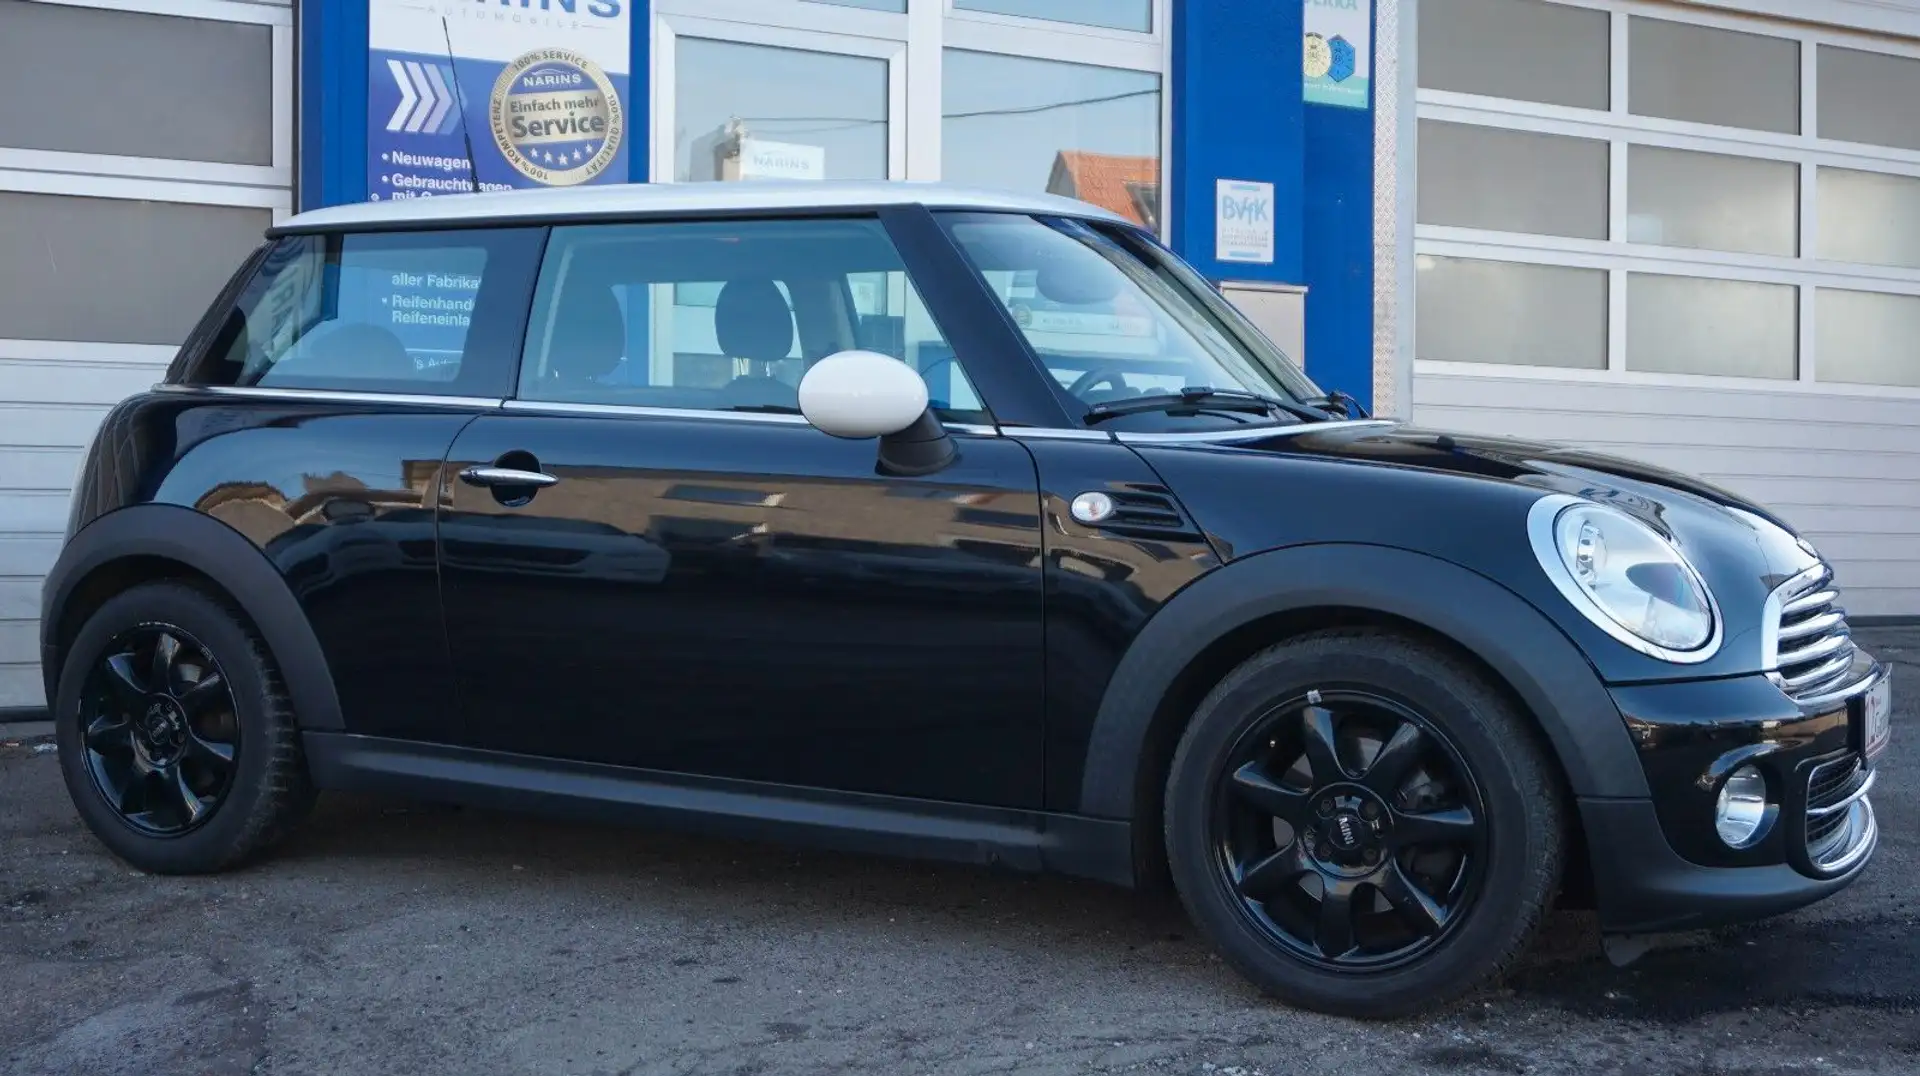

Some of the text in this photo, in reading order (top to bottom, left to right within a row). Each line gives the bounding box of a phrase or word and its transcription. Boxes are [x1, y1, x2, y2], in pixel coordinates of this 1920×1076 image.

[513, 50, 588, 70] 100% SERVICE
[523, 74, 581, 87] NARINS
[510, 95, 599, 113] Einfach mehr
[511, 111, 605, 138] Service
[392, 151, 471, 171] Neuwagen
[392, 272, 423, 287] aller
[392, 294, 475, 311] Reifenhand
